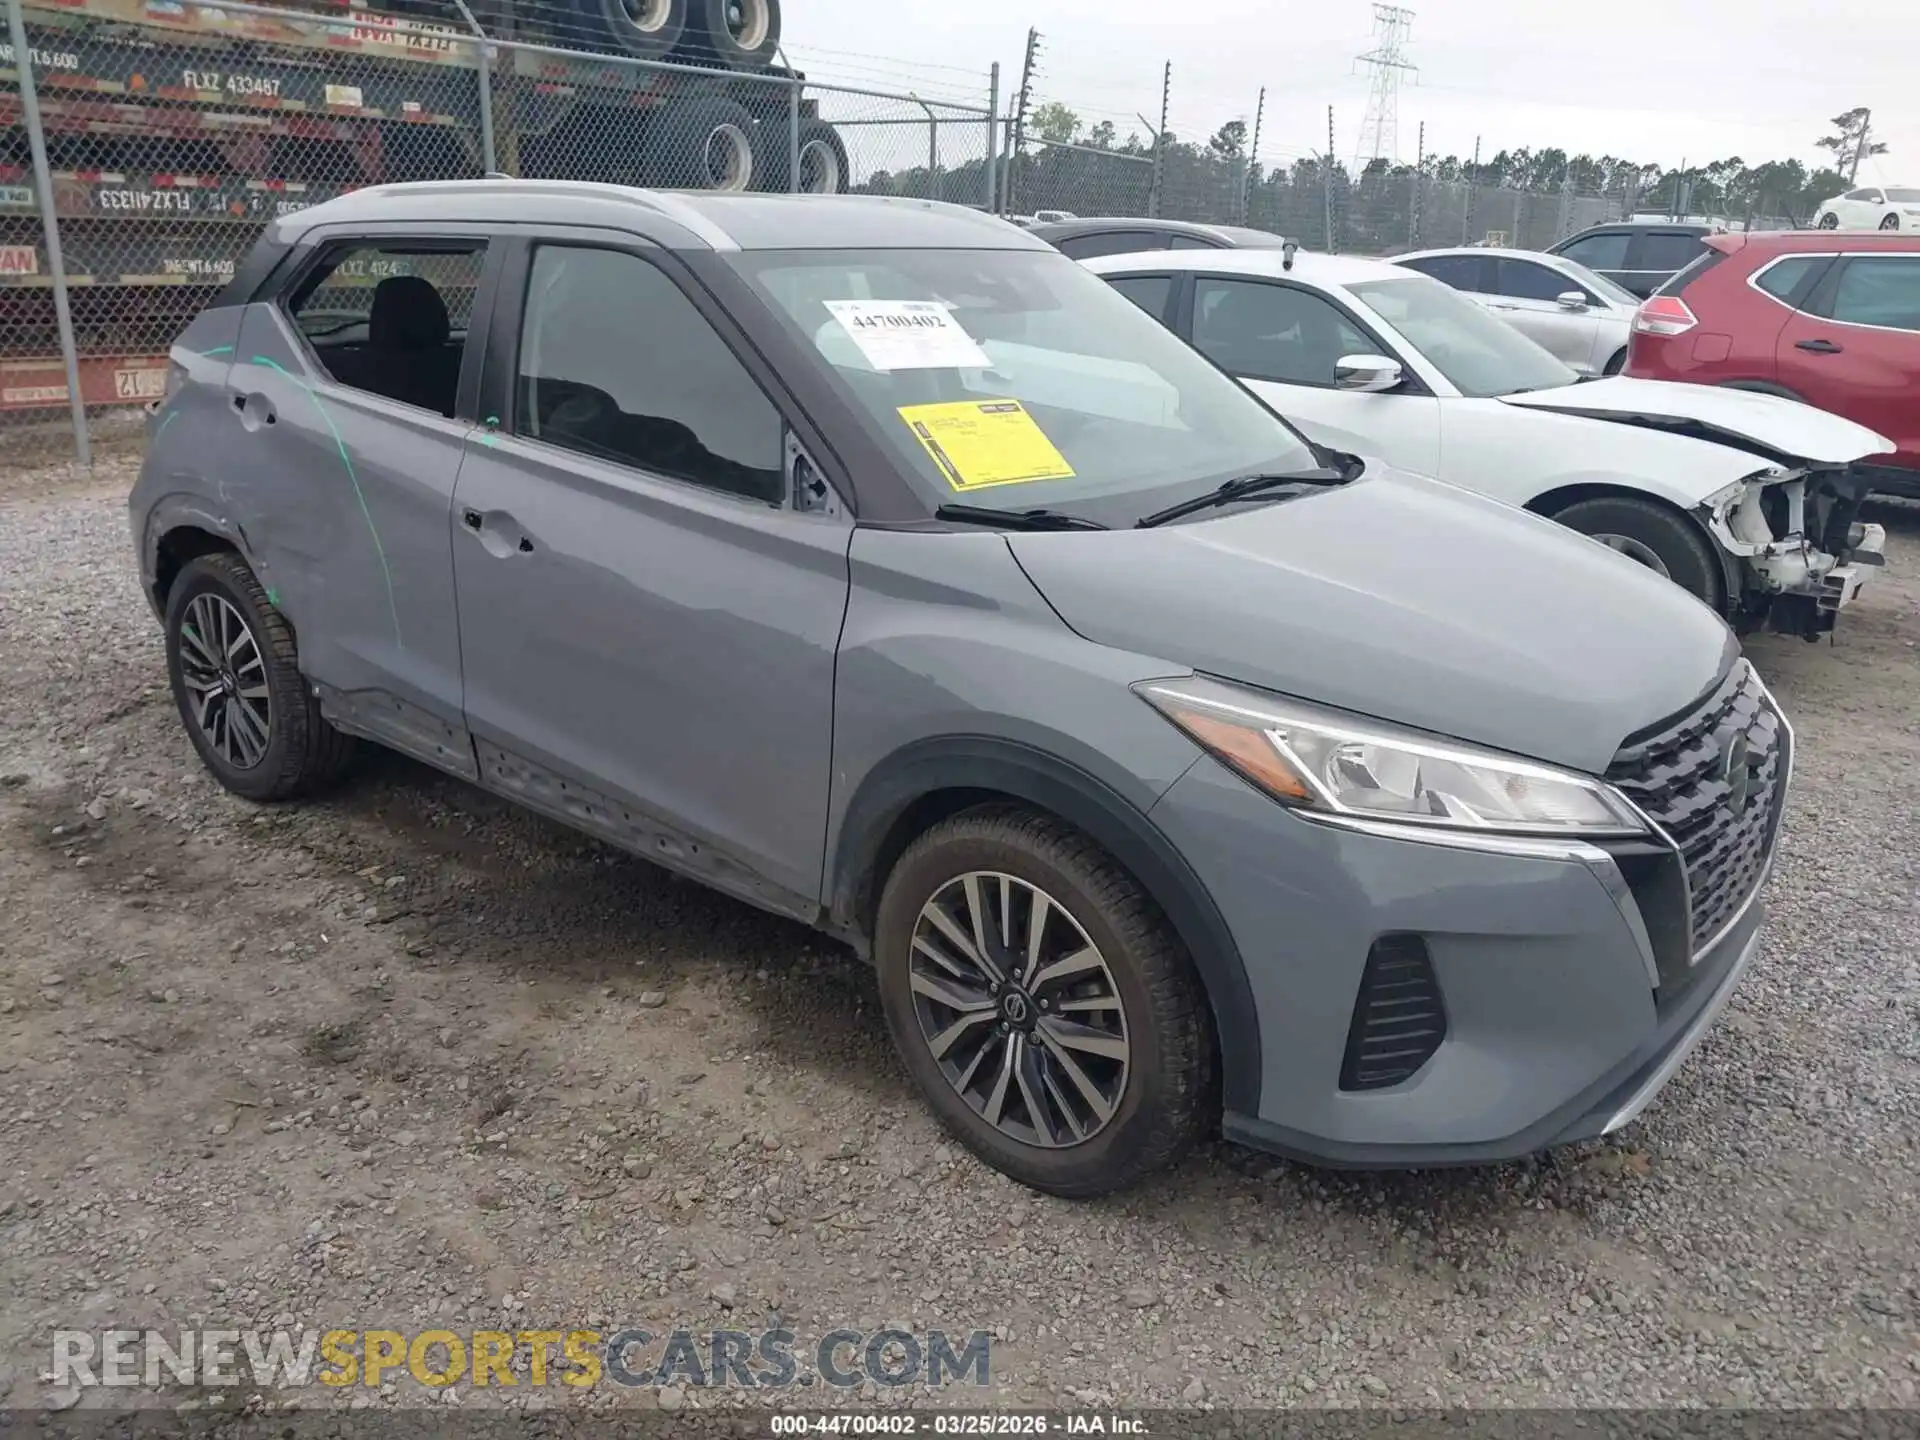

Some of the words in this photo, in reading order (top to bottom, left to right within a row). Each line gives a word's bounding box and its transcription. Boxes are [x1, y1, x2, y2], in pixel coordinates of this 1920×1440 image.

[183, 70, 221, 90] FLXZ
[0, 250, 32, 271] AN
[852, 314, 947, 329] 44700402
